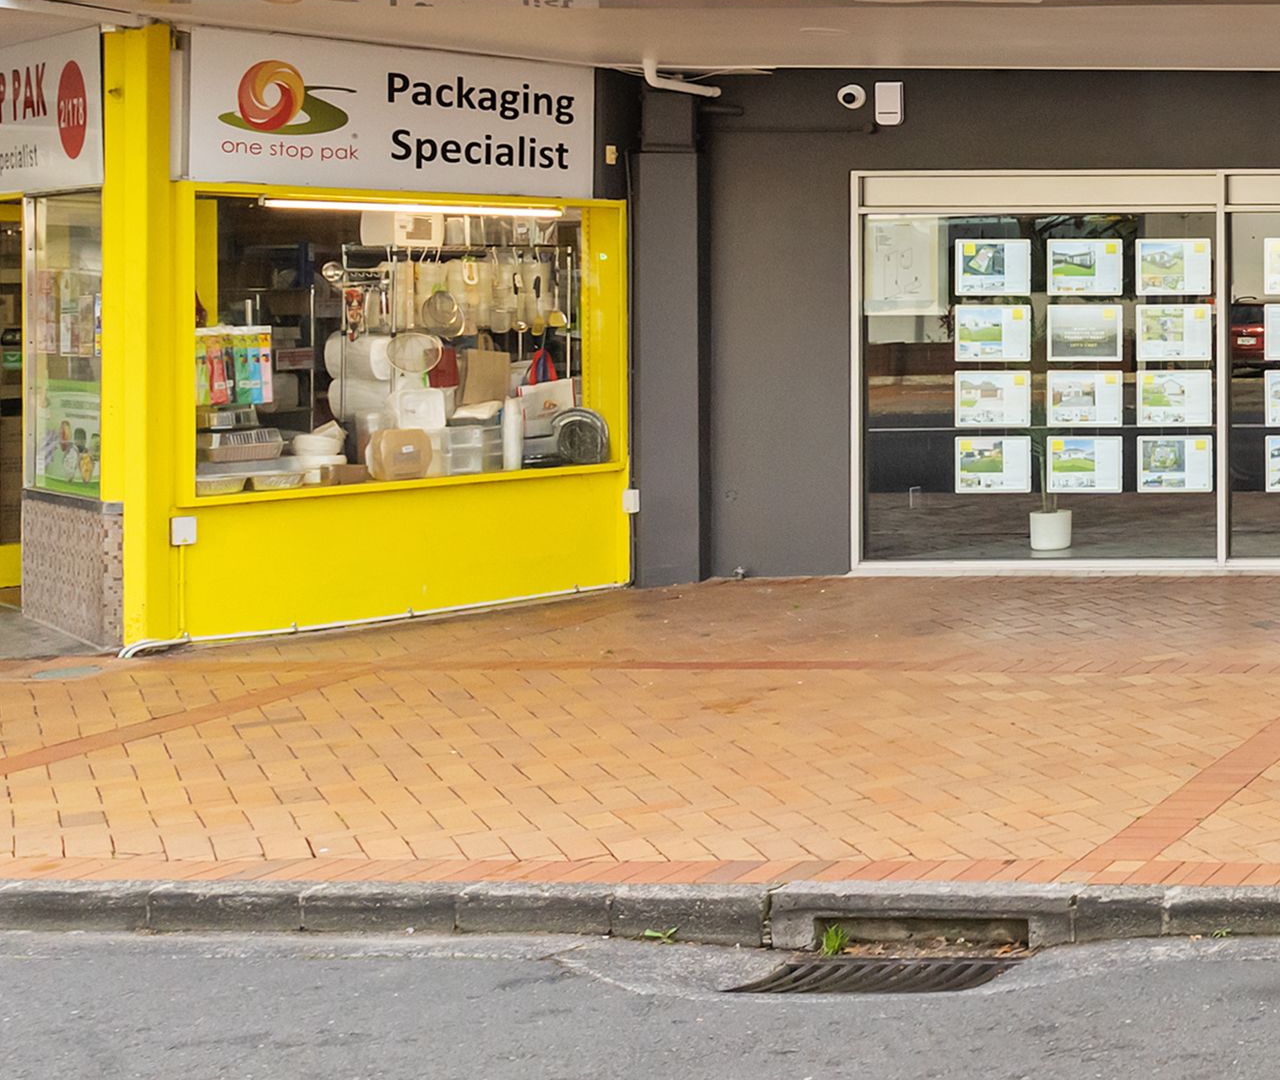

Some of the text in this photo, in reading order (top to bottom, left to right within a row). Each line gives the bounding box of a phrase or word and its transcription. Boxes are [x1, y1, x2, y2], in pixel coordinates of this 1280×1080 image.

[12, 61, 47, 122] PAK
[59, 96, 84, 129] 2/178
[387, 71, 575, 126] Packaging
[221, 140, 359, 161] one stop pak
[390, 129, 569, 171] Specialist
